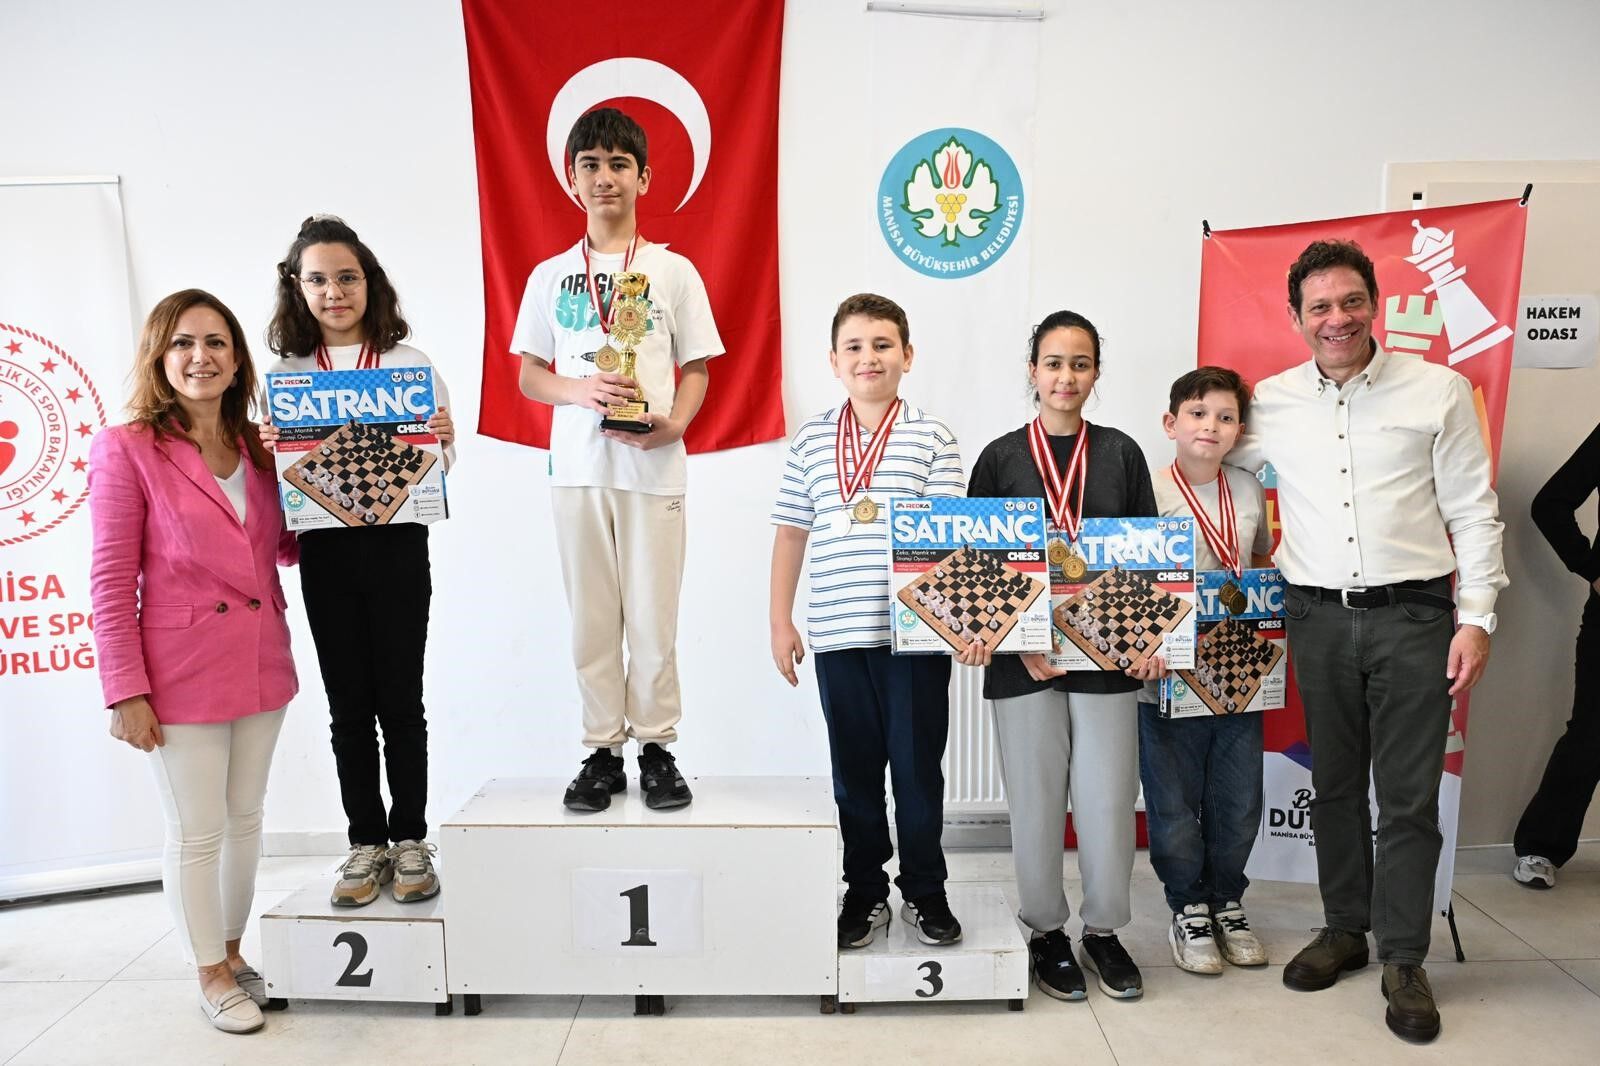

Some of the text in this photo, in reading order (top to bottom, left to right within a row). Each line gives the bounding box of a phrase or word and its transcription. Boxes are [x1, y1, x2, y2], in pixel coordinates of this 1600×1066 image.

[882, 195, 1018, 274] MANİSA BÜYÜKŞEHİR BELEDİYESİ
[1526, 306, 1581, 320] HAKEM
[1527, 327, 1578, 340] ODASI
[24, 378, 42, 396] VE
[38, 395, 61, 432] SPOR
[397, 423, 431, 434] CHESS
[6, 436, 61, 501] BAKANLIĞI
[1007, 551, 1040, 561] CHESS
[1157, 571, 1189, 581] CHESS
[0, 571, 65, 602] İSA
[1258, 620, 1282, 629] CHESS
[1270, 831, 1298, 839] MANİSA
[619, 884, 657, 947] 1
[332, 931, 374, 988] 2
[914, 960, 944, 998] 3
